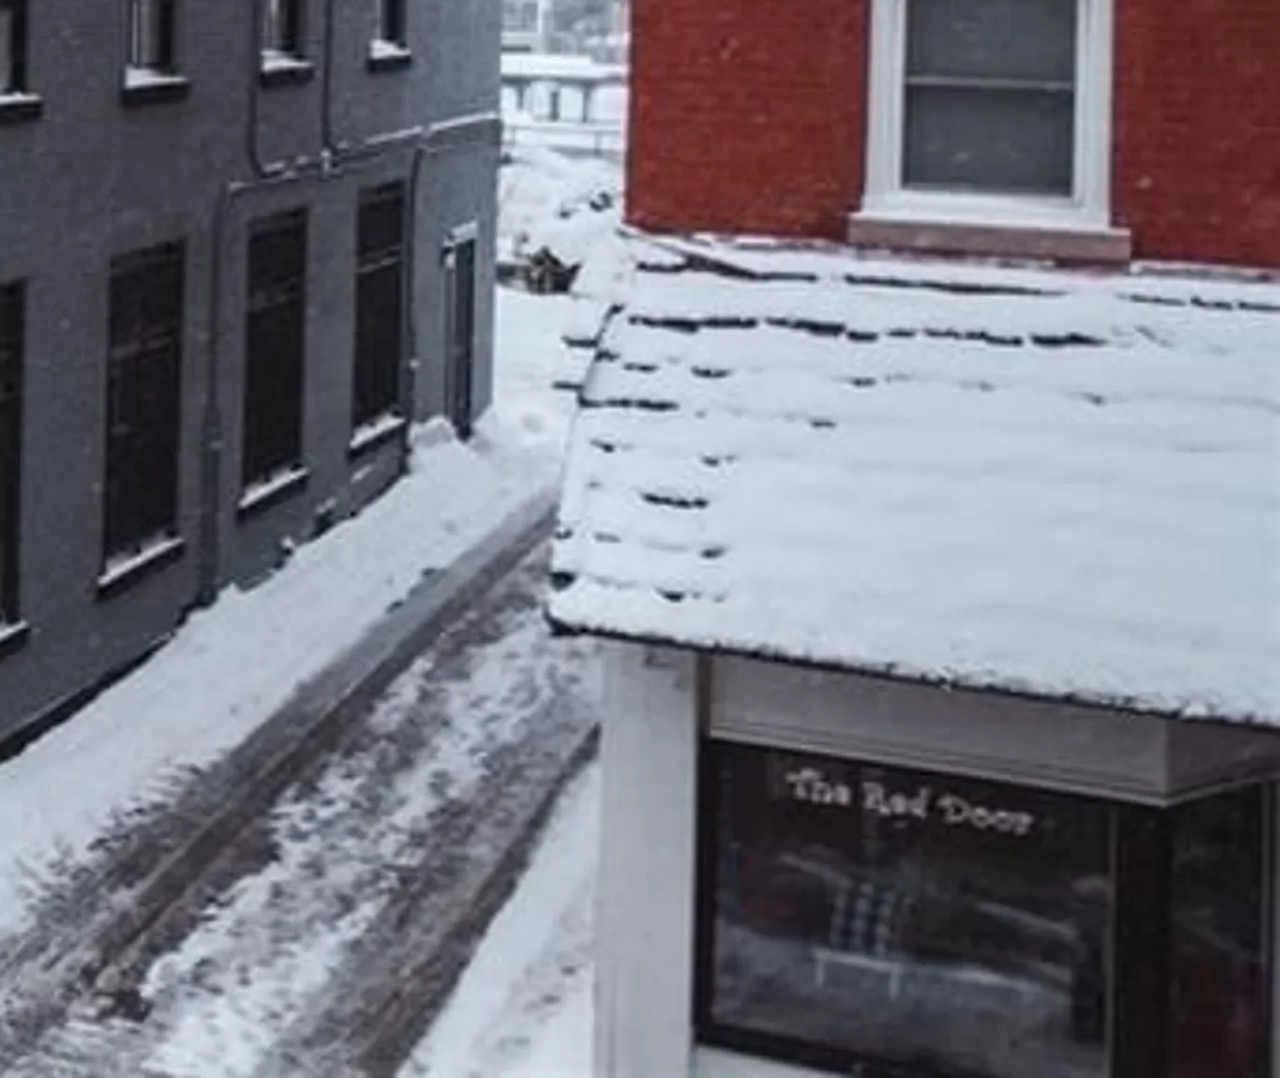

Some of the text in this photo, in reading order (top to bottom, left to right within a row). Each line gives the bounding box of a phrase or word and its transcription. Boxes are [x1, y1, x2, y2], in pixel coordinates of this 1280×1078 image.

[786, 767, 1034, 836] The Red Door
